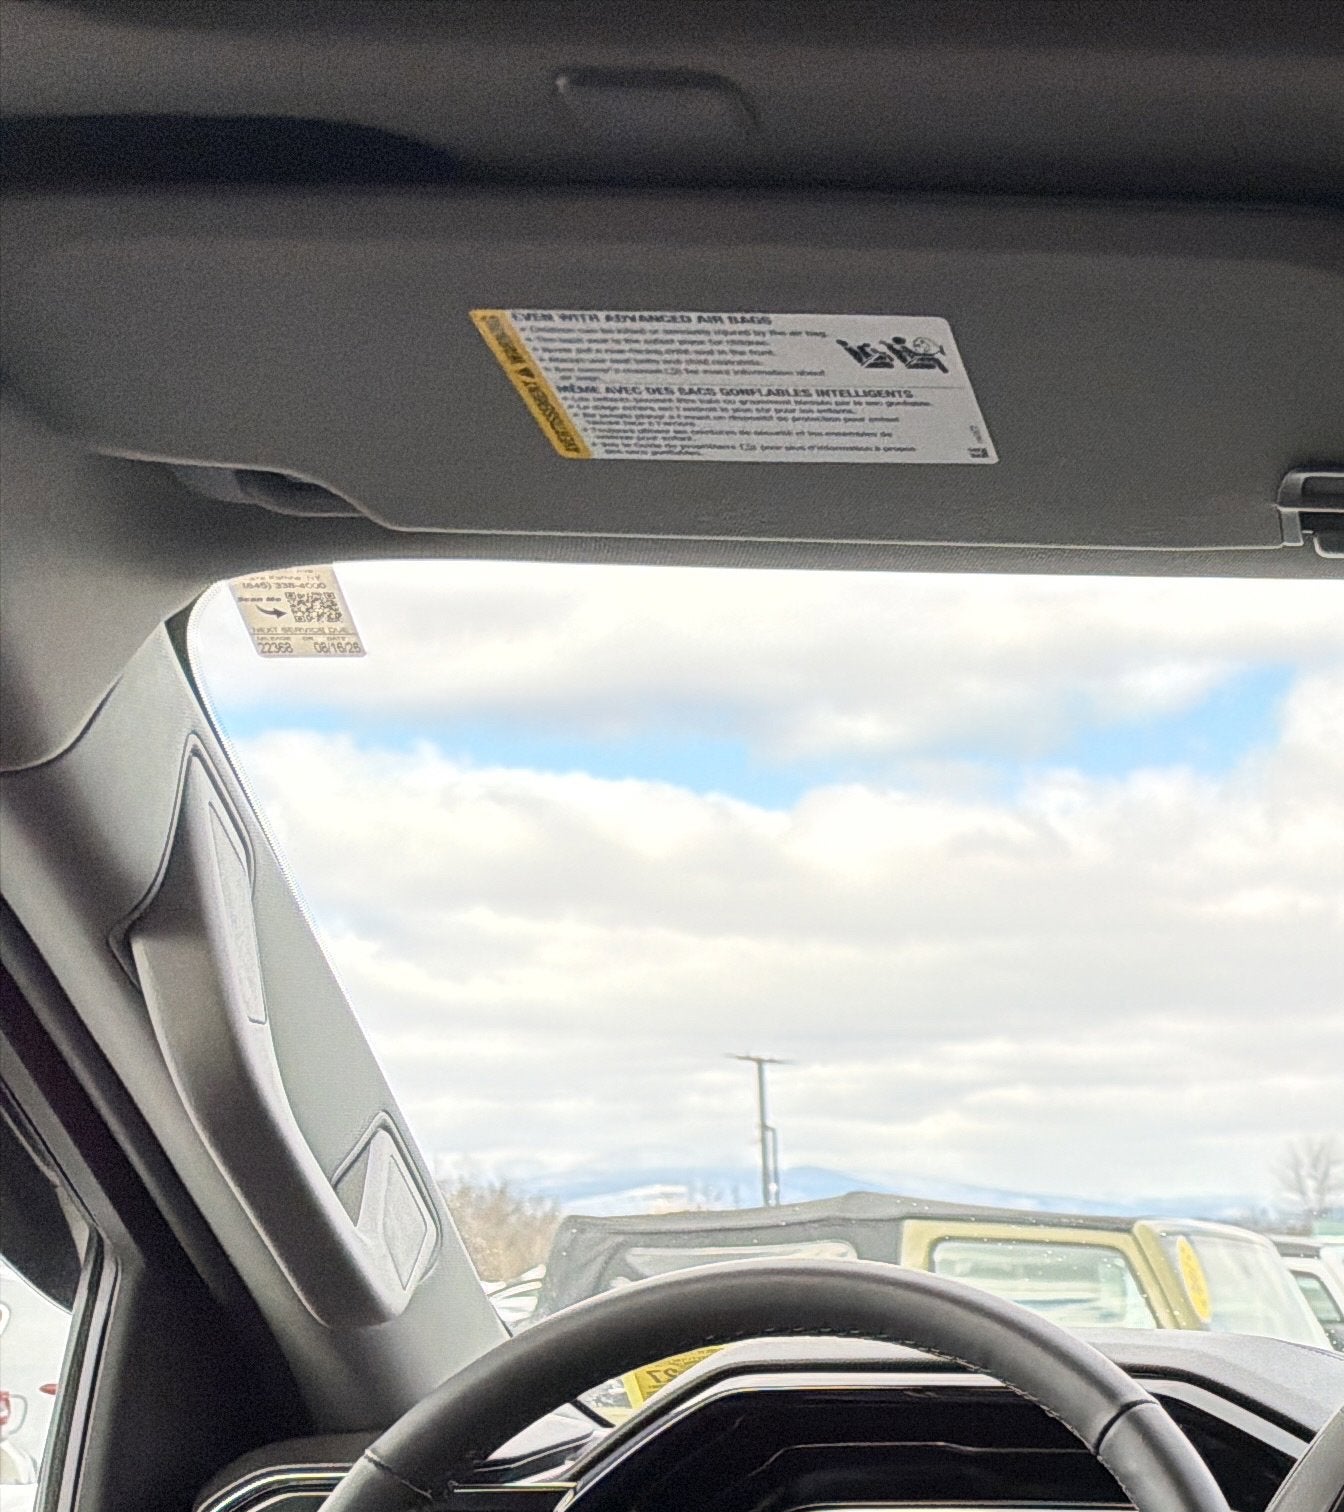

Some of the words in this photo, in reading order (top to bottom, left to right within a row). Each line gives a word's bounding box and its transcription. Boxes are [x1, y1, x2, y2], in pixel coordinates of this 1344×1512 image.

[697, 315, 723, 324] AIR
[605, 386, 642, 396] AVEC
[816, 388, 913, 399] INTELLIGENTS
